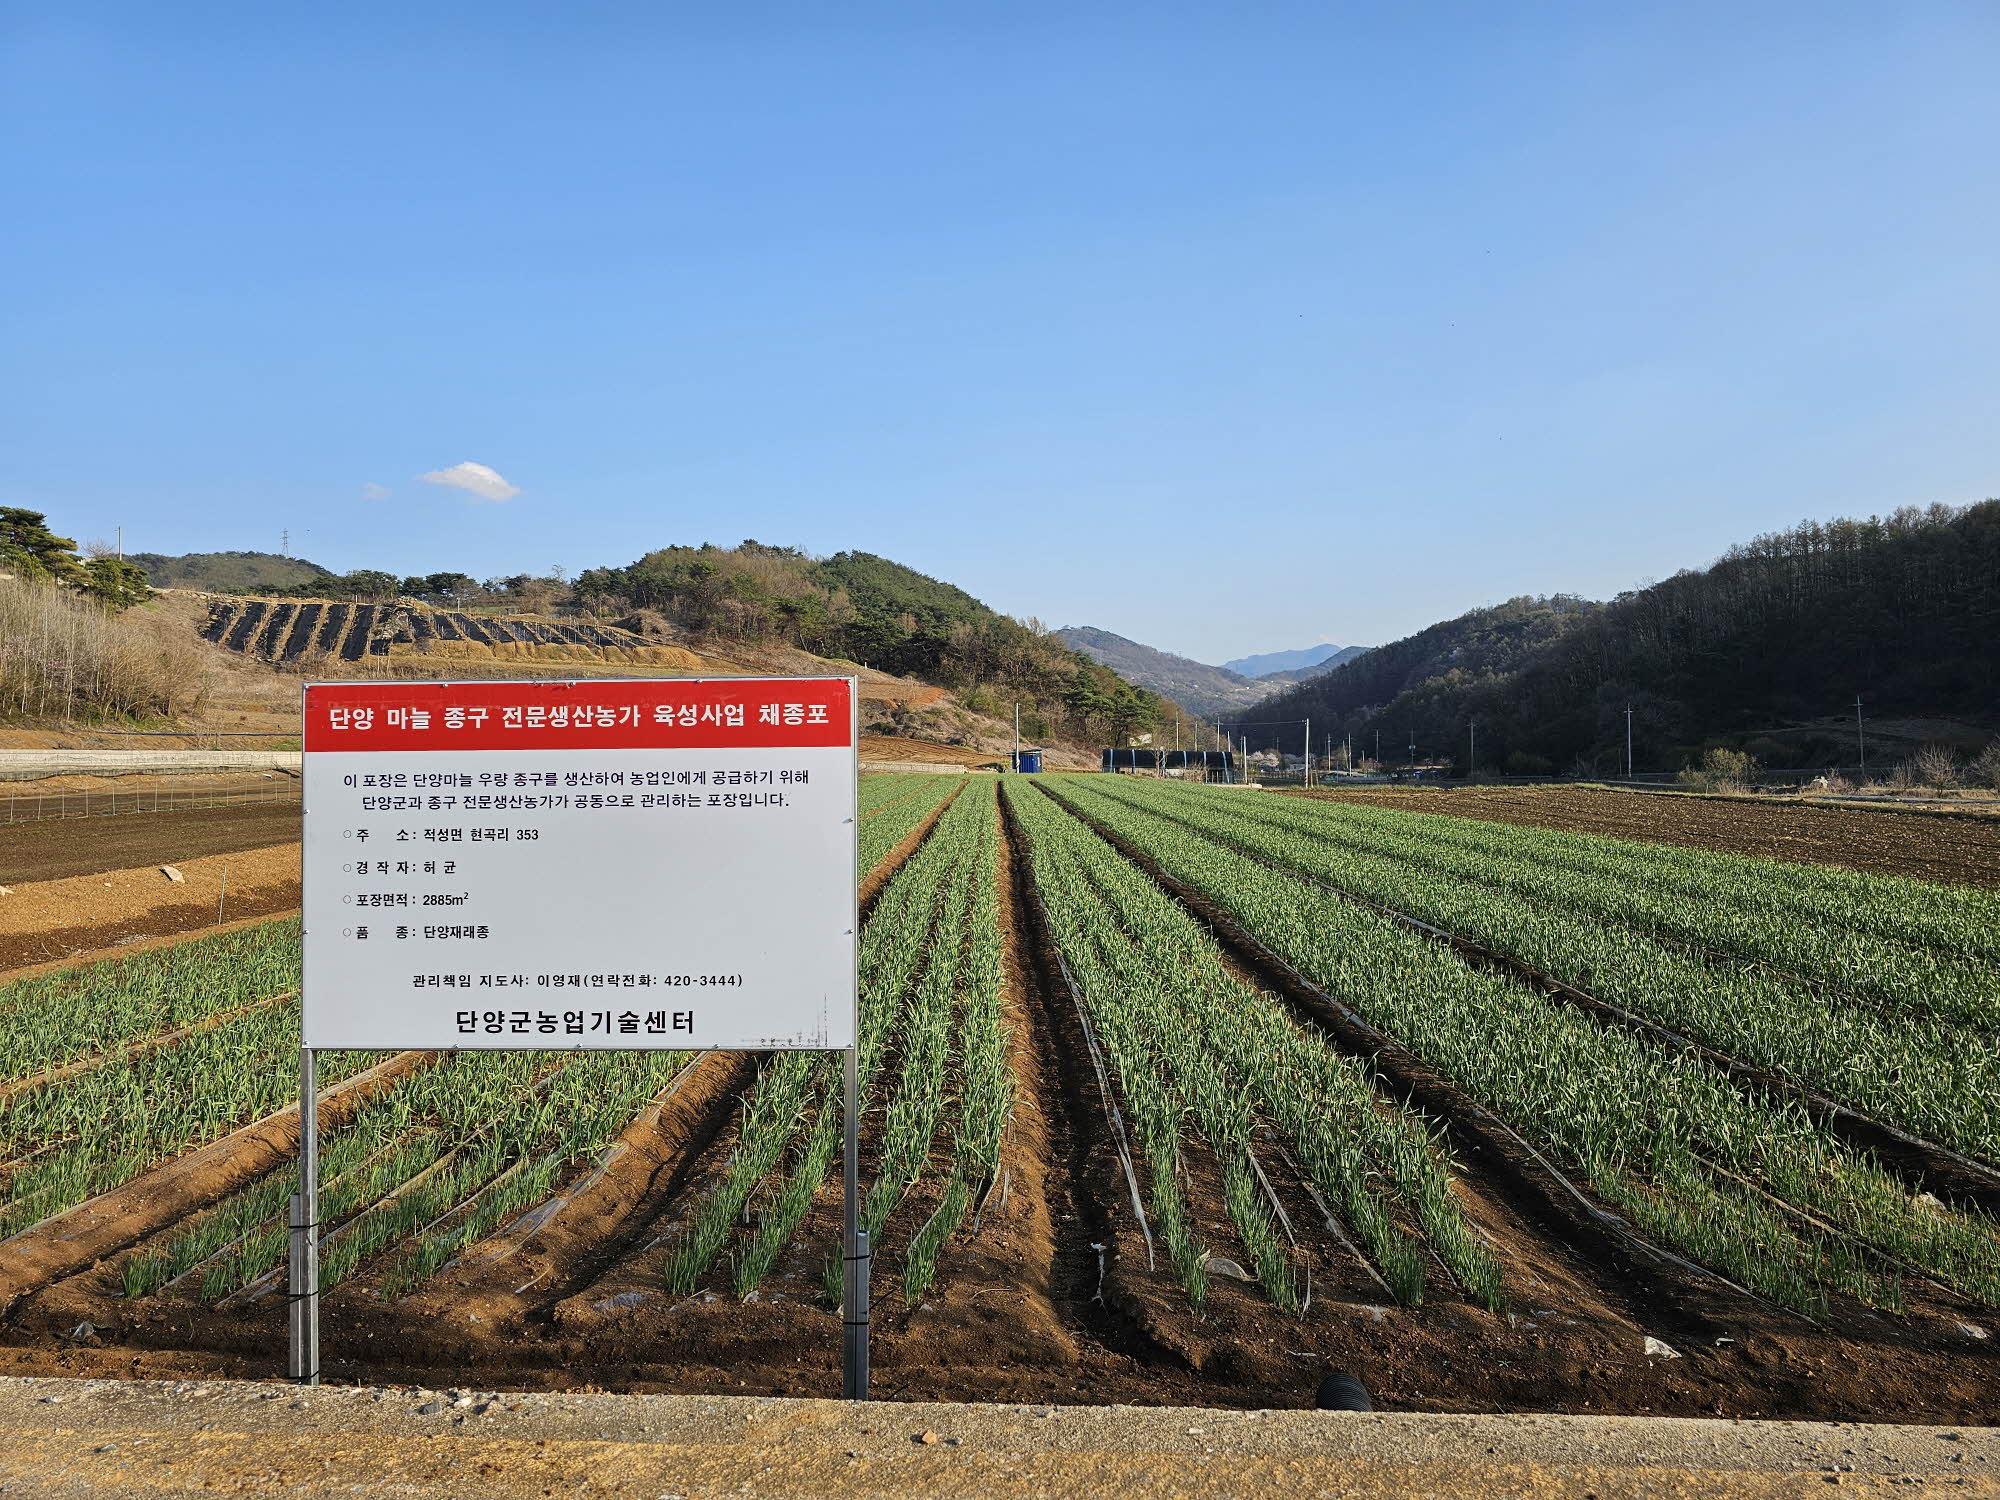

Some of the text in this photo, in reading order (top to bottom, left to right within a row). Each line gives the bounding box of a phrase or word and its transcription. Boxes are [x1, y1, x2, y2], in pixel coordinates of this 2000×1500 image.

[330, 703, 829, 730] 단양 마늘 종구 전문생산농가 육성사업 채종포
[343, 769, 809, 789] 이 포장은 단양마늘 우량 종구를 생산하여 농업인에게 공급하기 위해
[362, 792, 789, 811] 단양군과 종구 전문생산농가가 공동으로 관리하는 포장입니다.
[356, 829, 370, 843] 주
[423, 828, 463, 842] 적성면
[470, 827, 509, 842] 현곡리
[516, 828, 539, 841] 353
[356, 860, 369, 875] 경
[376, 860, 390, 875] 작
[423, 860, 436, 875] 허
[443, 860, 457, 875] 균
[356, 925, 369, 940] 품
[423, 925, 490, 940] 단양재래종
[412, 974, 472, 988] 관리책임
[479, 974, 529, 988] 지도사:
[663, 973, 743, 988] 420-3444)
[456, 1010, 694, 1035] 단양군농업기술센터
